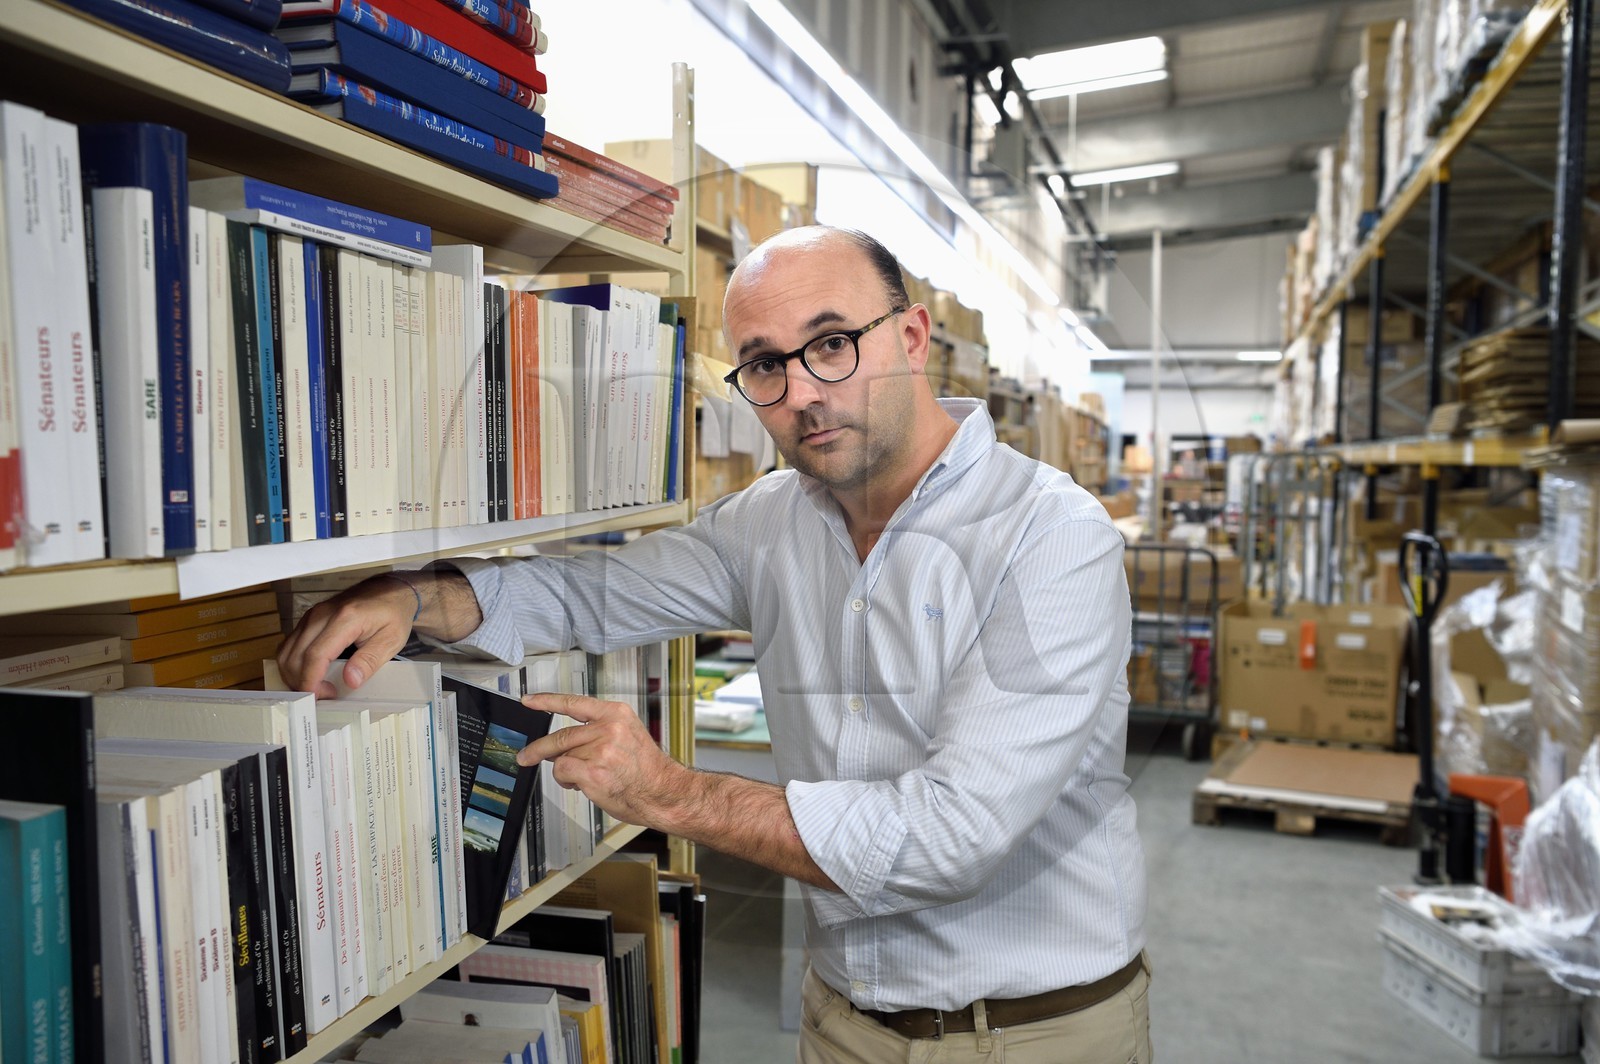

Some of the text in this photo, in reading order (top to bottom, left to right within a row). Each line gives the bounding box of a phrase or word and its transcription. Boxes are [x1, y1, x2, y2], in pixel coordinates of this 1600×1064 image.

[431, 46, 489, 87] Saint-Jean-de-Luz
[326, 206, 348, 219] française
[348, 212, 373, 225] Révolution
[35, 327, 57, 432] Sénateurs
[70, 332, 88, 433] Sénateurs
[275, 373, 283, 396] loups
[144, 379, 157, 420] SARE
[294, 368, 302, 424] contre-courant
[279, 446, 285, 459] La
[198, 607, 217, 619] SUCRE
[197, 630, 217, 642] SUCRE
[7, 662, 32, 675] Harlem
[38, 657, 57, 668] saison
[211, 652, 228, 664] SUCRE
[229, 788, 240, 832] Jean Cau
[364, 746, 378, 869] LA SURFACE DE RÉPARATION
[441, 798, 447, 808] de
[430, 833, 438, 864] SARE
[314, 852, 326, 931] Sénateurs
[333, 829, 348, 966] De la sensualité du pommier
[347, 822, 361, 955] De la sensualité du pommier
[392, 878, 400, 908] Source
[236, 905, 250, 967] Sévillanes
[254, 940, 262, 958] d'Or
[282, 929, 290, 946] d'Or
[289, 899, 300, 995] de l'architecture hispanique
[261, 909, 273, 1008] de l'architecture hispanique
